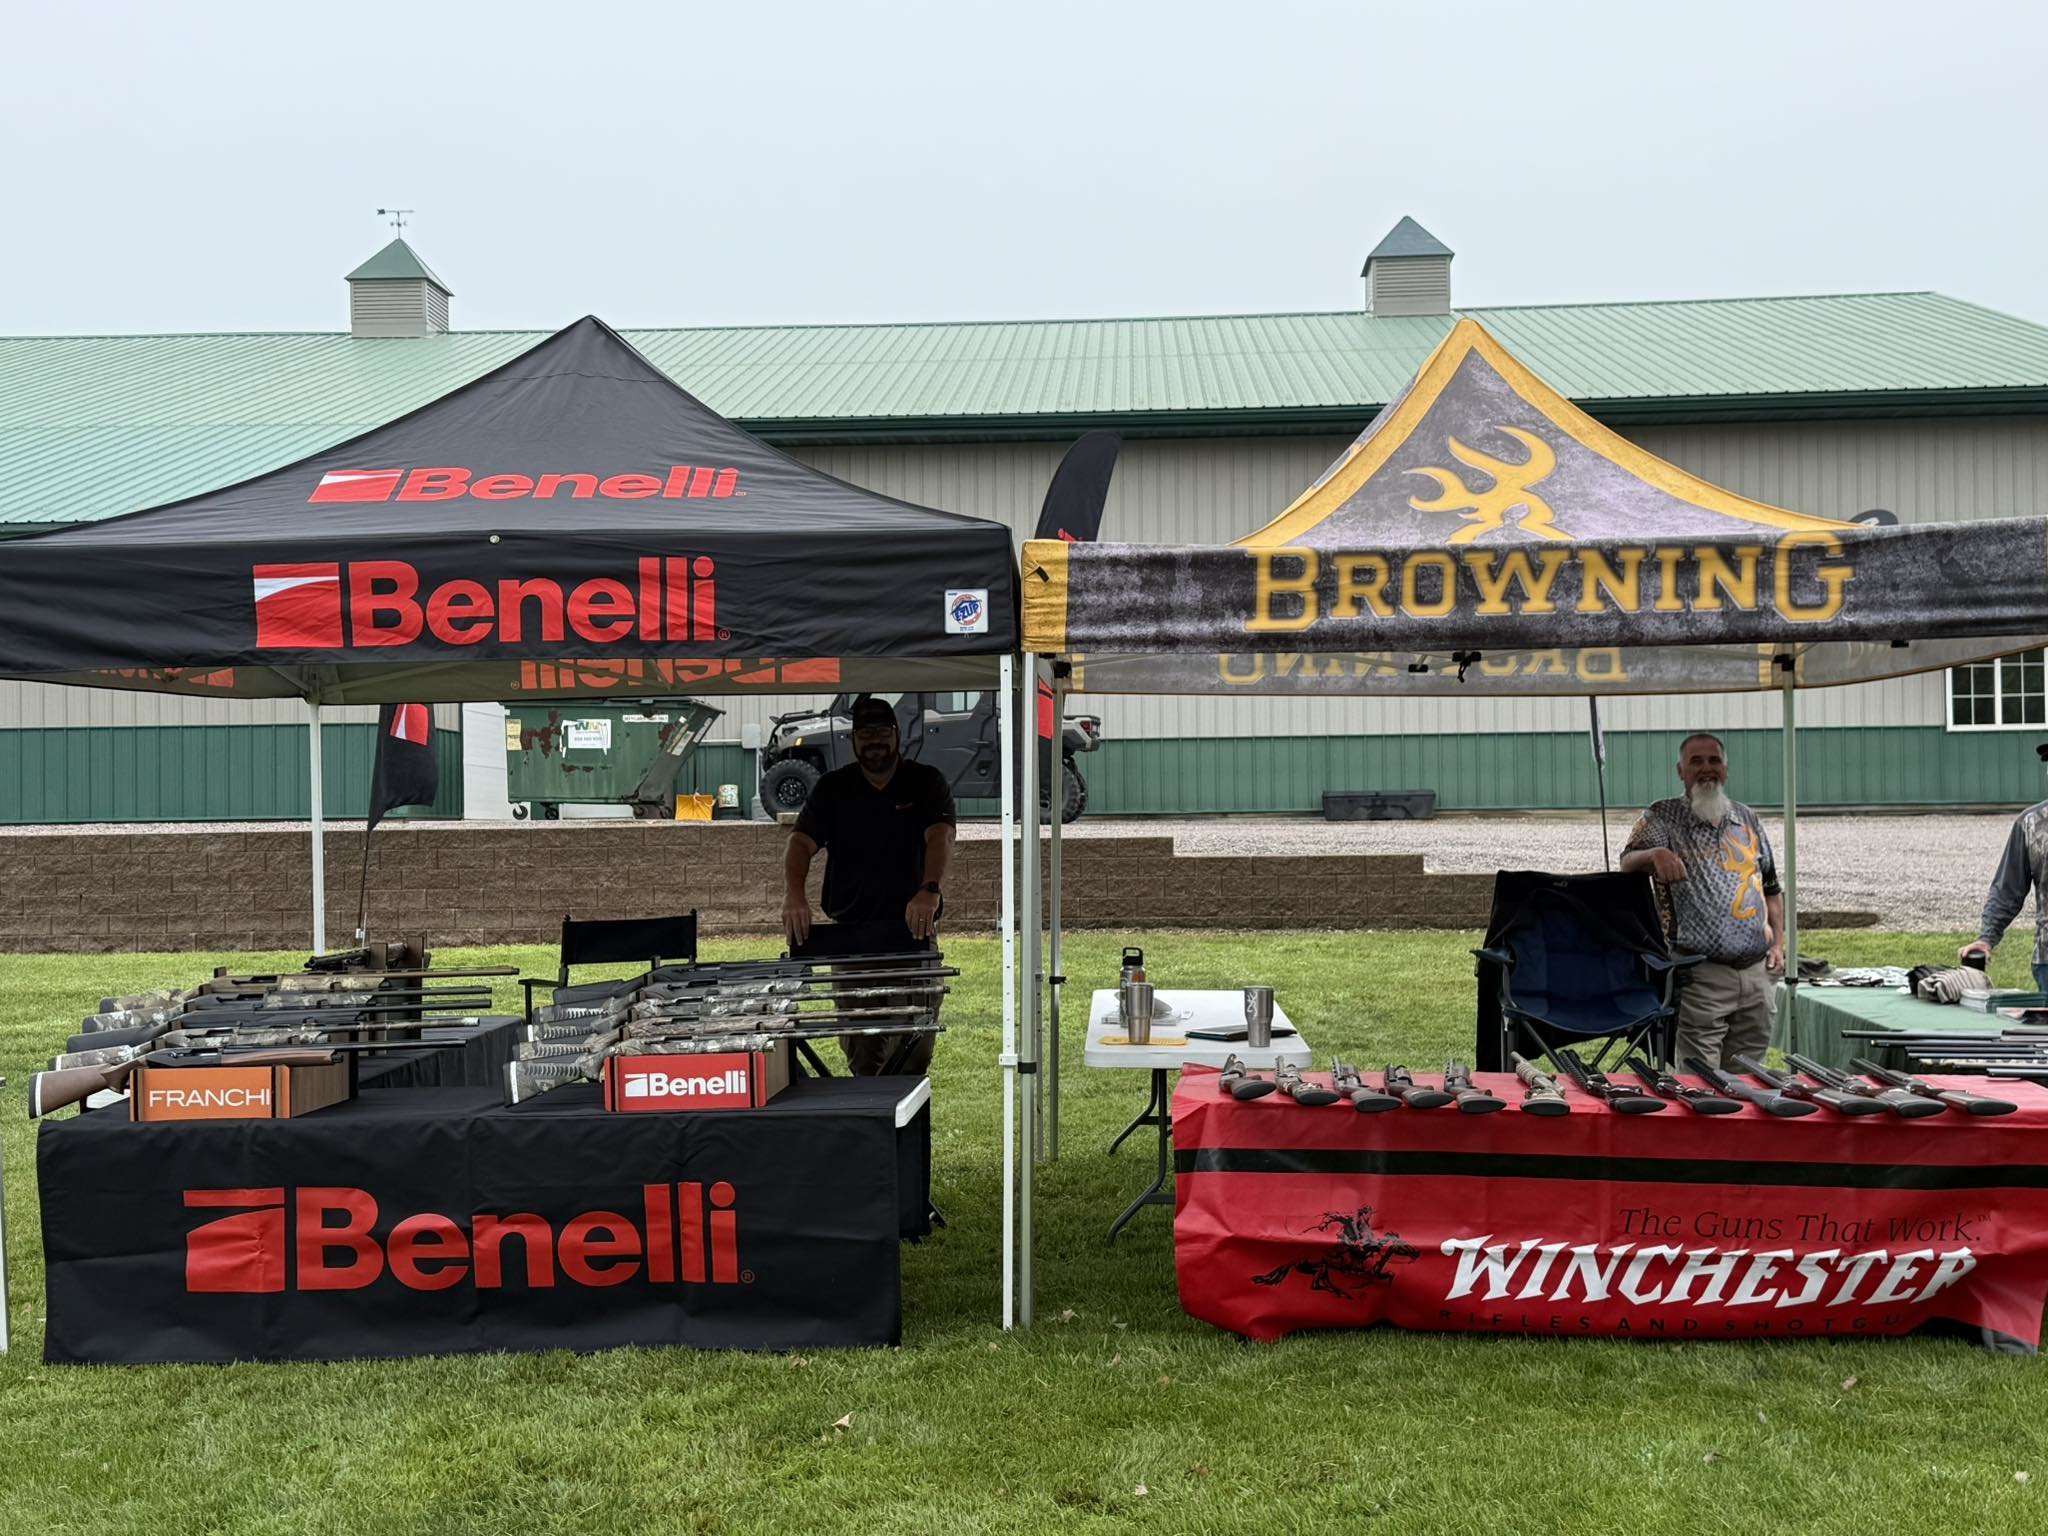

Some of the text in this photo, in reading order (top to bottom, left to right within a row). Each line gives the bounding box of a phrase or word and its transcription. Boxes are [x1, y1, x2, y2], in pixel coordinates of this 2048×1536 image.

[396, 465, 739, 501] Benelli
[1244, 532, 1855, 632] BROWNING
[348, 556, 716, 647] Benelli
[149, 1088, 270, 1107] FRANCHI
[650, 1070, 746, 1097] Benelli
[296, 1181, 738, 1290] Benelli
[1619, 1208, 1681, 1236] The
[1694, 1211, 1782, 1240] Guns
[1796, 1212, 1872, 1242] That
[1440, 1234, 1978, 1309] WINCHESTER
[1439, 1309, 1591, 1330] RIFLES
[1616, 1316, 1698, 1333] AND
